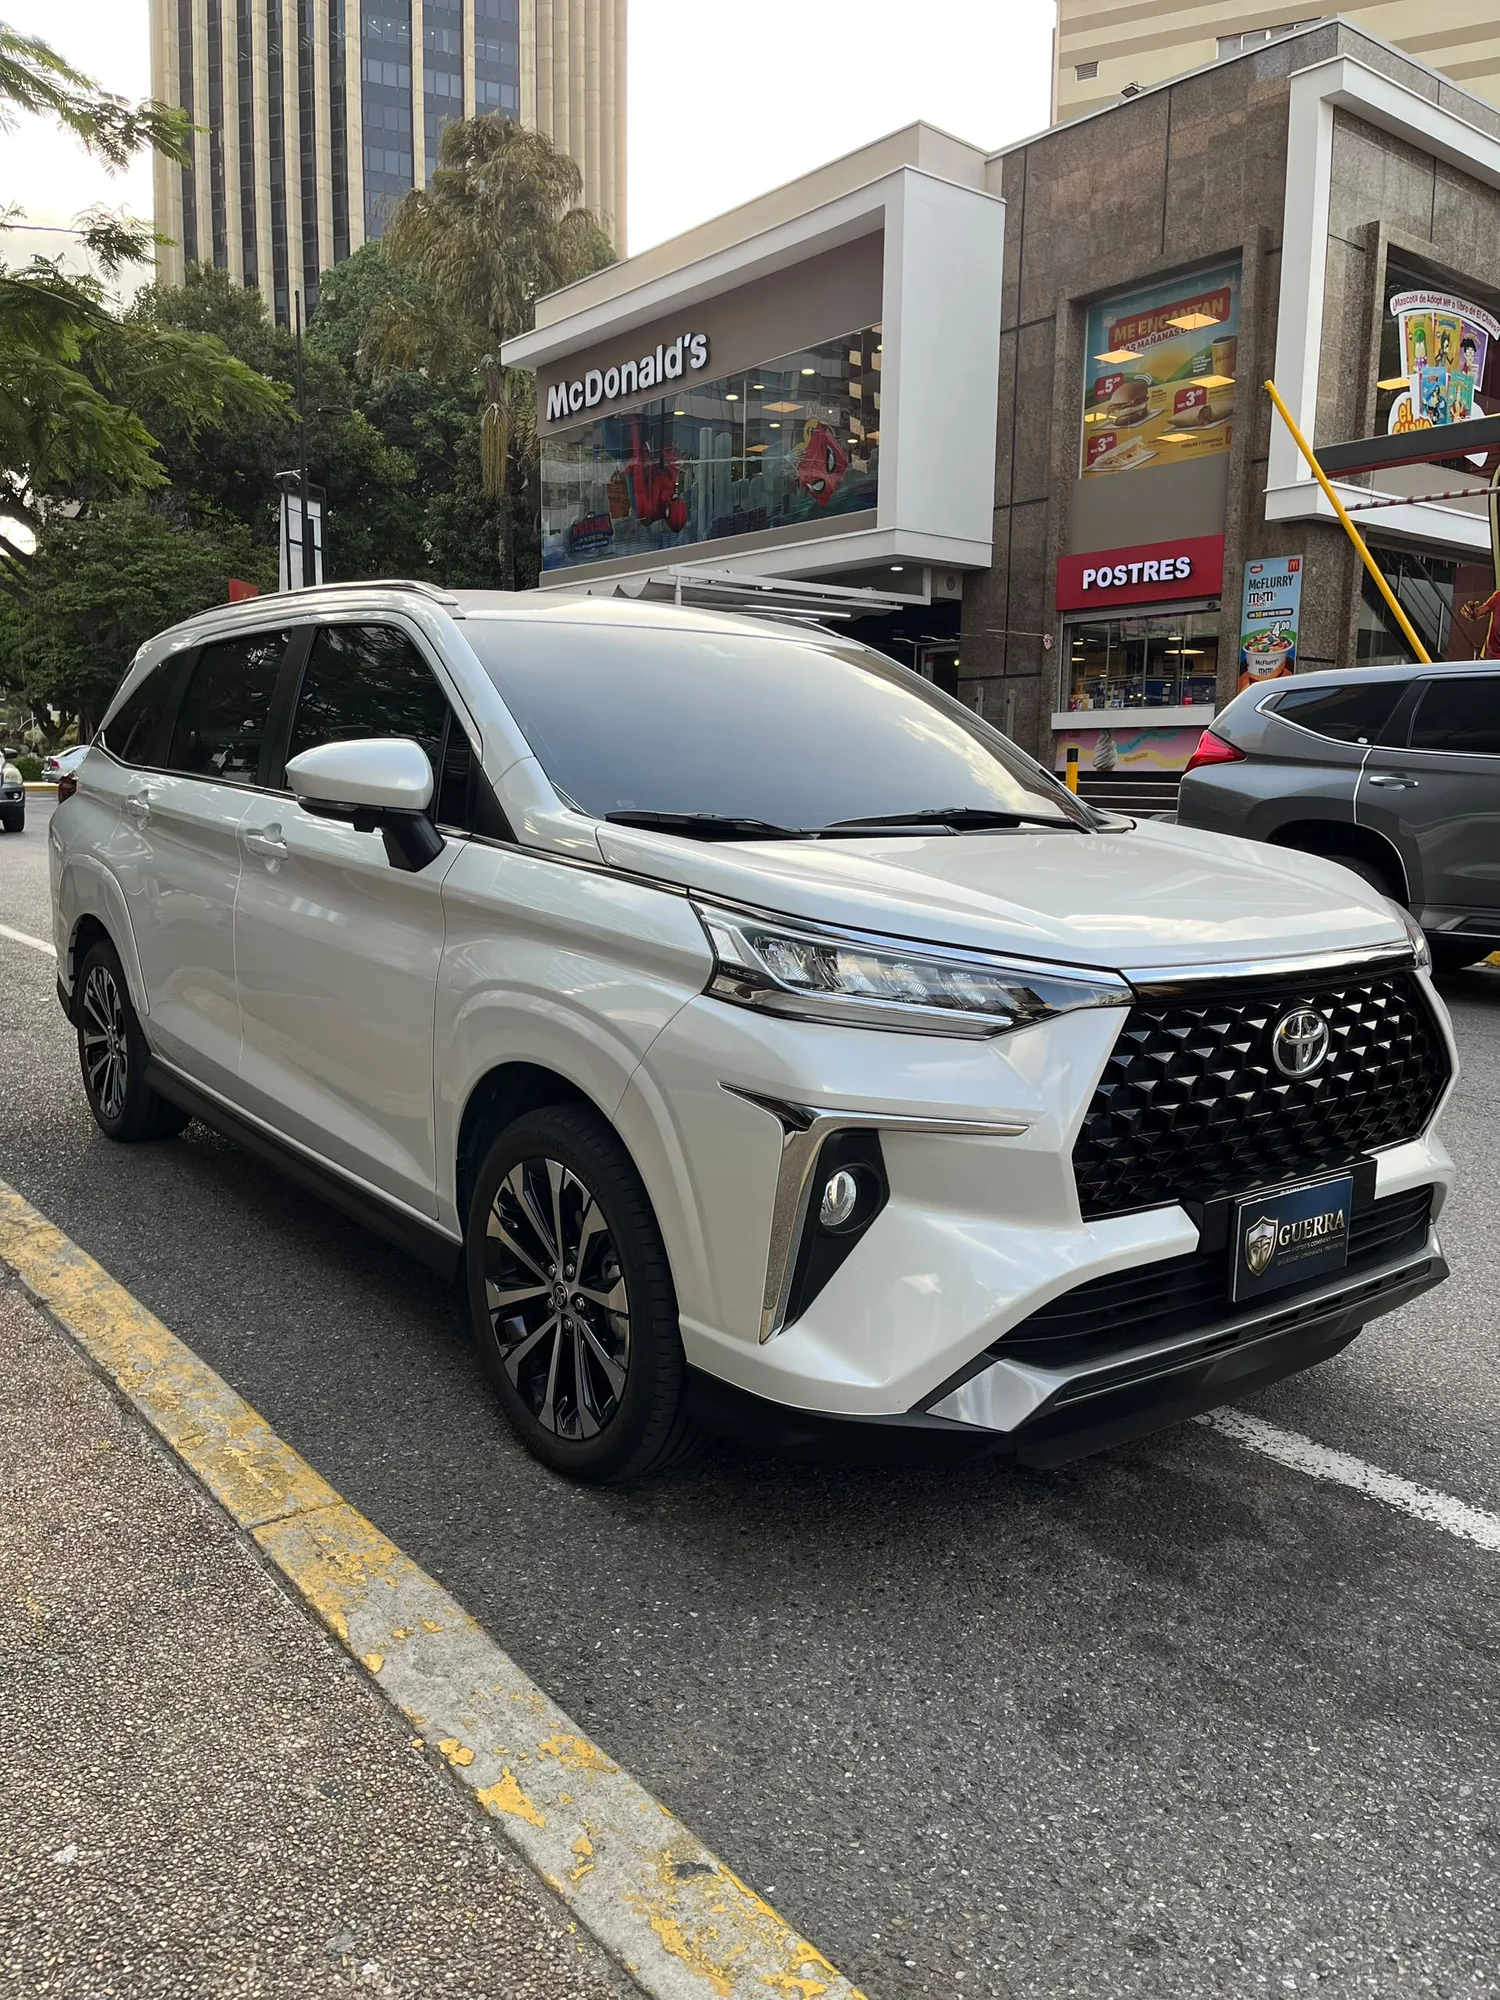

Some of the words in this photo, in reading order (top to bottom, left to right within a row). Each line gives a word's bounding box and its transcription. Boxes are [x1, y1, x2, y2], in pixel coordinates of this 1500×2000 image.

[1419, 294, 1426, 303] de
[1427, 294, 1442, 306] Adopt
[1452, 301, 1456, 309] o
[1469, 307, 1476, 315] de
[1114, 322, 1136, 343] ME
[1137, 329, 1180, 349] MAÑANAS
[546, 332, 709, 421] McDonald's
[1082, 556, 1191, 590] POSTRES
[1248, 574, 1294, 590] McFLURRY
[722, 966, 759, 981] VELOZ
[1278, 1209, 1346, 1246] GUERRA
